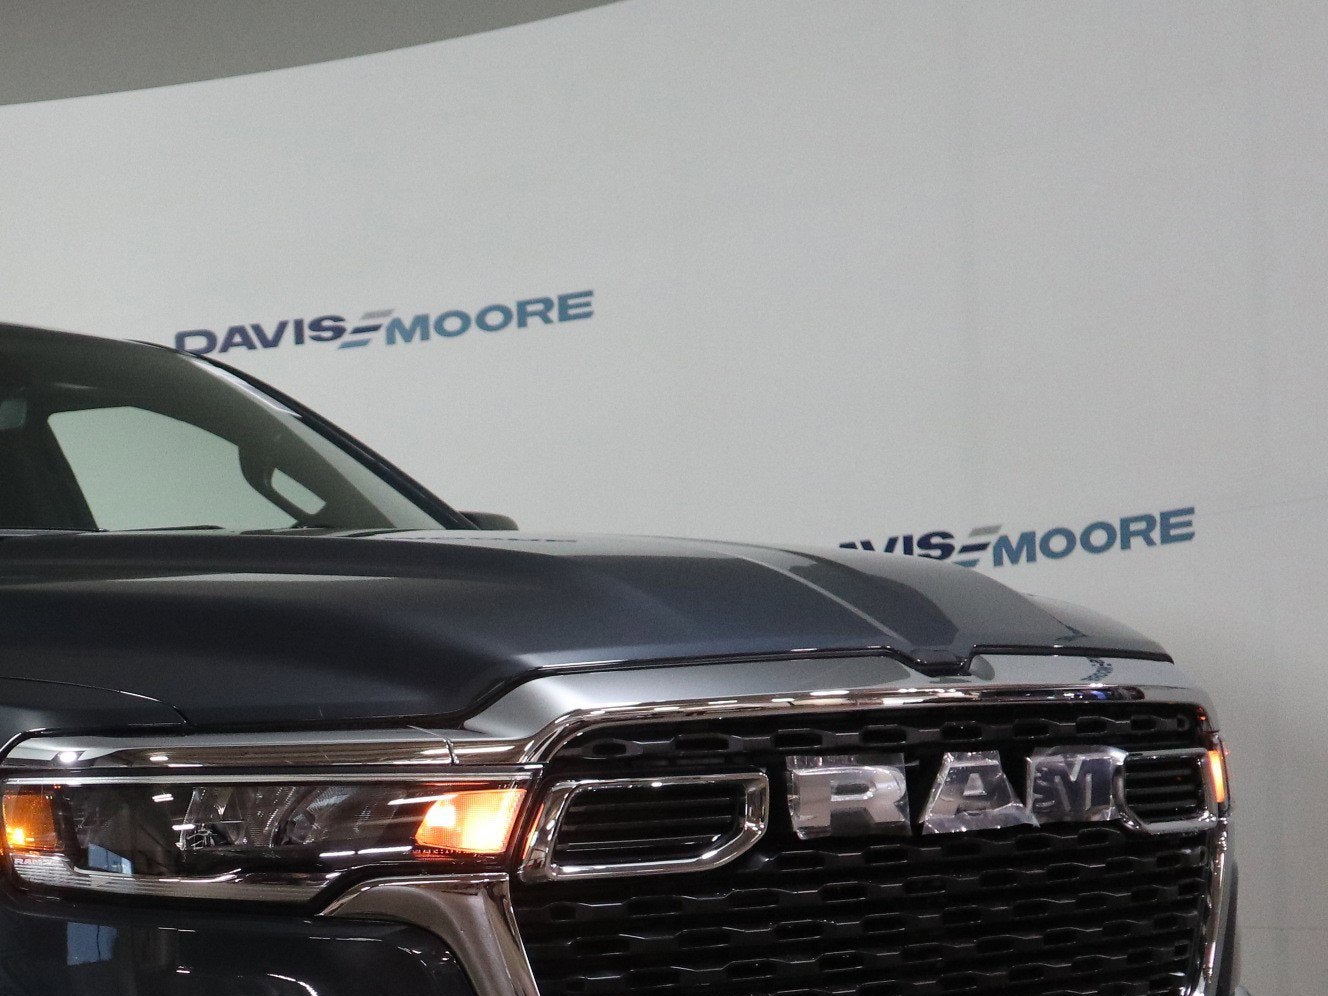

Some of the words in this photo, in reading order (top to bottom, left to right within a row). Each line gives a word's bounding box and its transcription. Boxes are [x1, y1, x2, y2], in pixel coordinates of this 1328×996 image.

[175, 314, 347, 355] DAVIS
[385, 290, 595, 346] MOORE
[993, 507, 1195, 567] MOORE
[786, 746, 1127, 840] RAM
